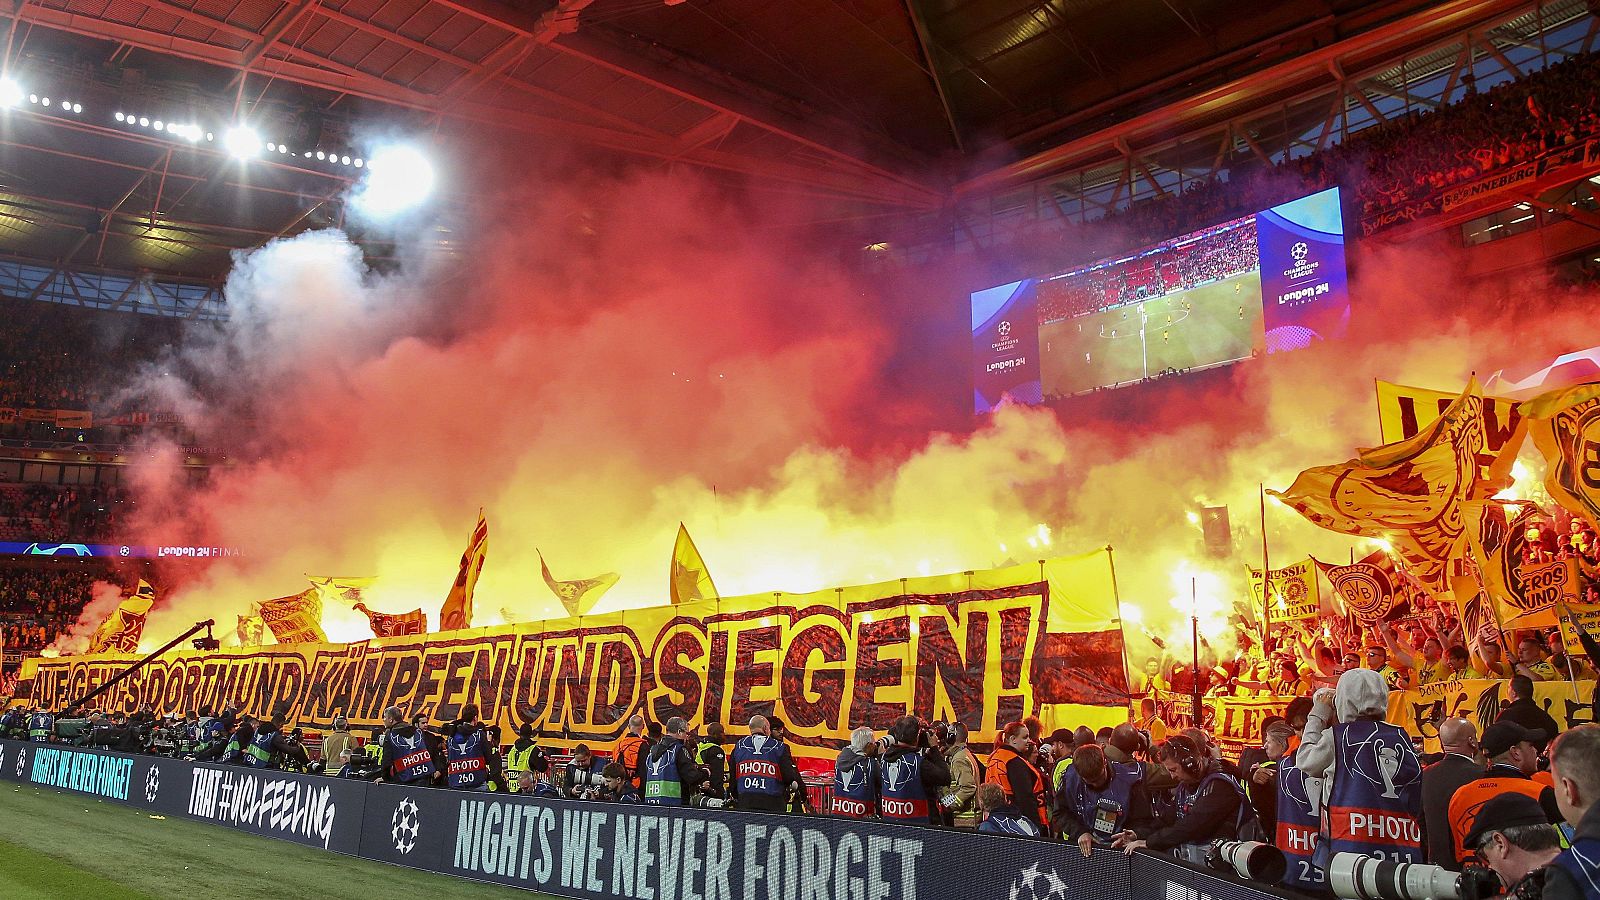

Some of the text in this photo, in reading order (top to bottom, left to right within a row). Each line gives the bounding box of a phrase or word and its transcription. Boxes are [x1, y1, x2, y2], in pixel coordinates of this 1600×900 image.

[1283, 262, 1319, 276] CHAMPIONS
[1290, 269, 1314, 279] LEAGUE
[1315, 282, 1329, 295] 24
[991, 338, 1019, 349] CHAMPIONS
[996, 344, 1015, 352] LEAGUE
[1015, 357, 1026, 366] 24
[196, 547, 210, 557] 24
[212, 547, 246, 557] FINAL
[1329, 566, 1374, 582] BORUSSIA
[1523, 567, 1563, 591] EROS
[1346, 581, 1372, 601] BVB
[1526, 587, 1558, 608] UND
[1268, 605, 1317, 619] RTMUND
[29, 667, 69, 712] AUF
[149, 660, 302, 717] DORTMUND
[303, 643, 507, 721] KÄMPFEN
[514, 640, 637, 725] UND
[652, 606, 1031, 733] SIEGEN!
[402, 750, 431, 767] PHOTO
[451, 759, 480, 771] PHOTO
[31, 747, 60, 786] NIGHTS
[57, 750, 72, 788] WE
[69, 752, 98, 794] NEVER
[96, 755, 134, 801] FORGET
[411, 764, 428, 776] 156
[739, 761, 776, 775] PHOTO
[458, 772, 475, 784] 260
[744, 777, 767, 789] 041
[188, 767, 223, 819] THAT
[831, 798, 866, 815] HOTO
[1288, 828, 1319, 851] PHO
[453, 799, 924, 900] NIGHTS WE NEVER FORGET
